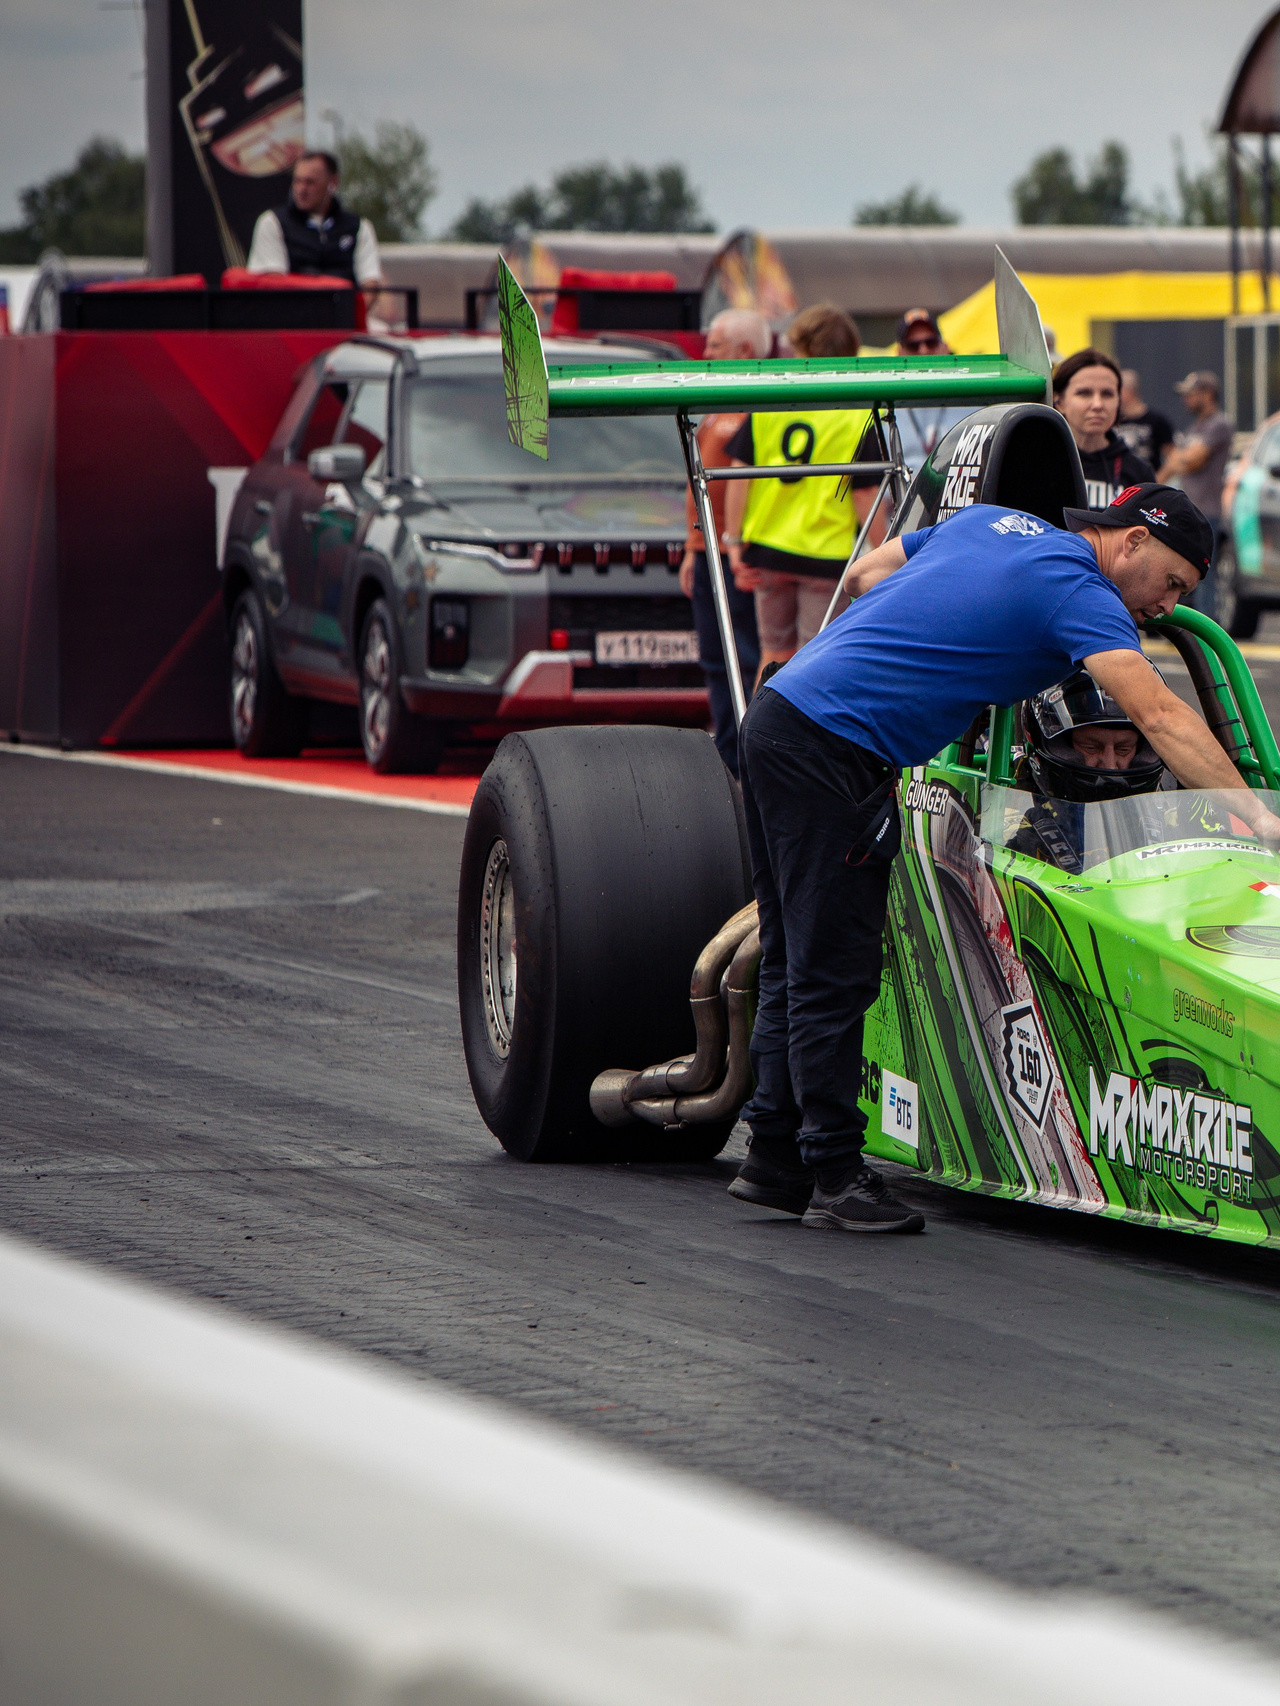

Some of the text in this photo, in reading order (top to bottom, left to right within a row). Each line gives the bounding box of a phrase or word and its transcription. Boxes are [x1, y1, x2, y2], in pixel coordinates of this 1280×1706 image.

[779, 422, 815, 484] 9
[950, 424, 996, 466] MAX
[940, 466, 980, 508] RIDE
[1173, 988, 1234, 1038] greenworks
[1018, 1043, 1042, 1089] 160
[896, 1096, 912, 1130] ВТБ
[1140, 1147, 1253, 1199] MOTORSPORT
